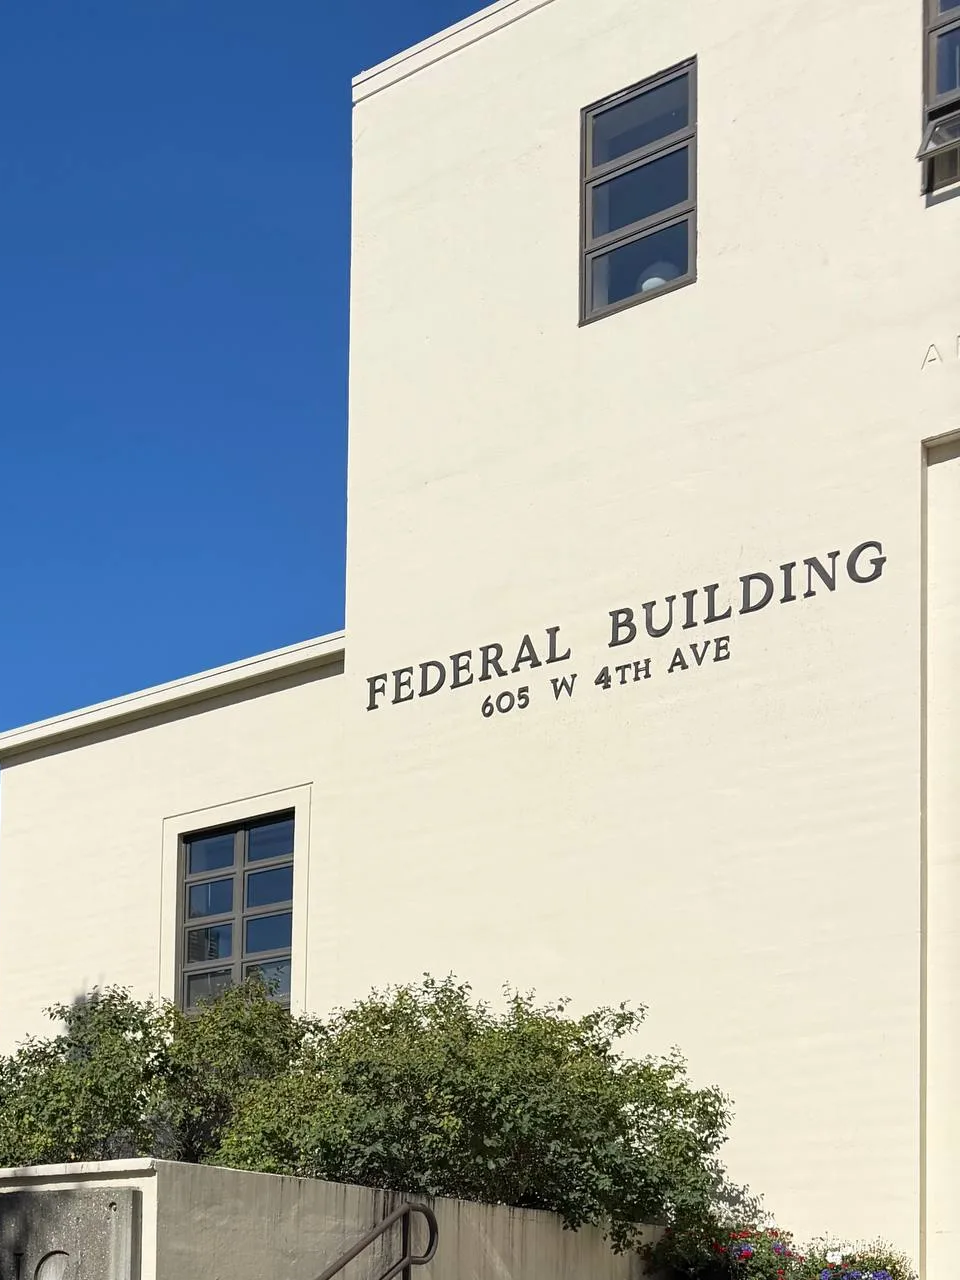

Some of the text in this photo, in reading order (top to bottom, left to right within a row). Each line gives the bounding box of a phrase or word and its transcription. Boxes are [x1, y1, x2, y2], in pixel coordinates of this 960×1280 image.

[366, 540, 887, 712] FEDERAL BUILDING
[481, 635, 731, 718] 605 W 4TH AVE
